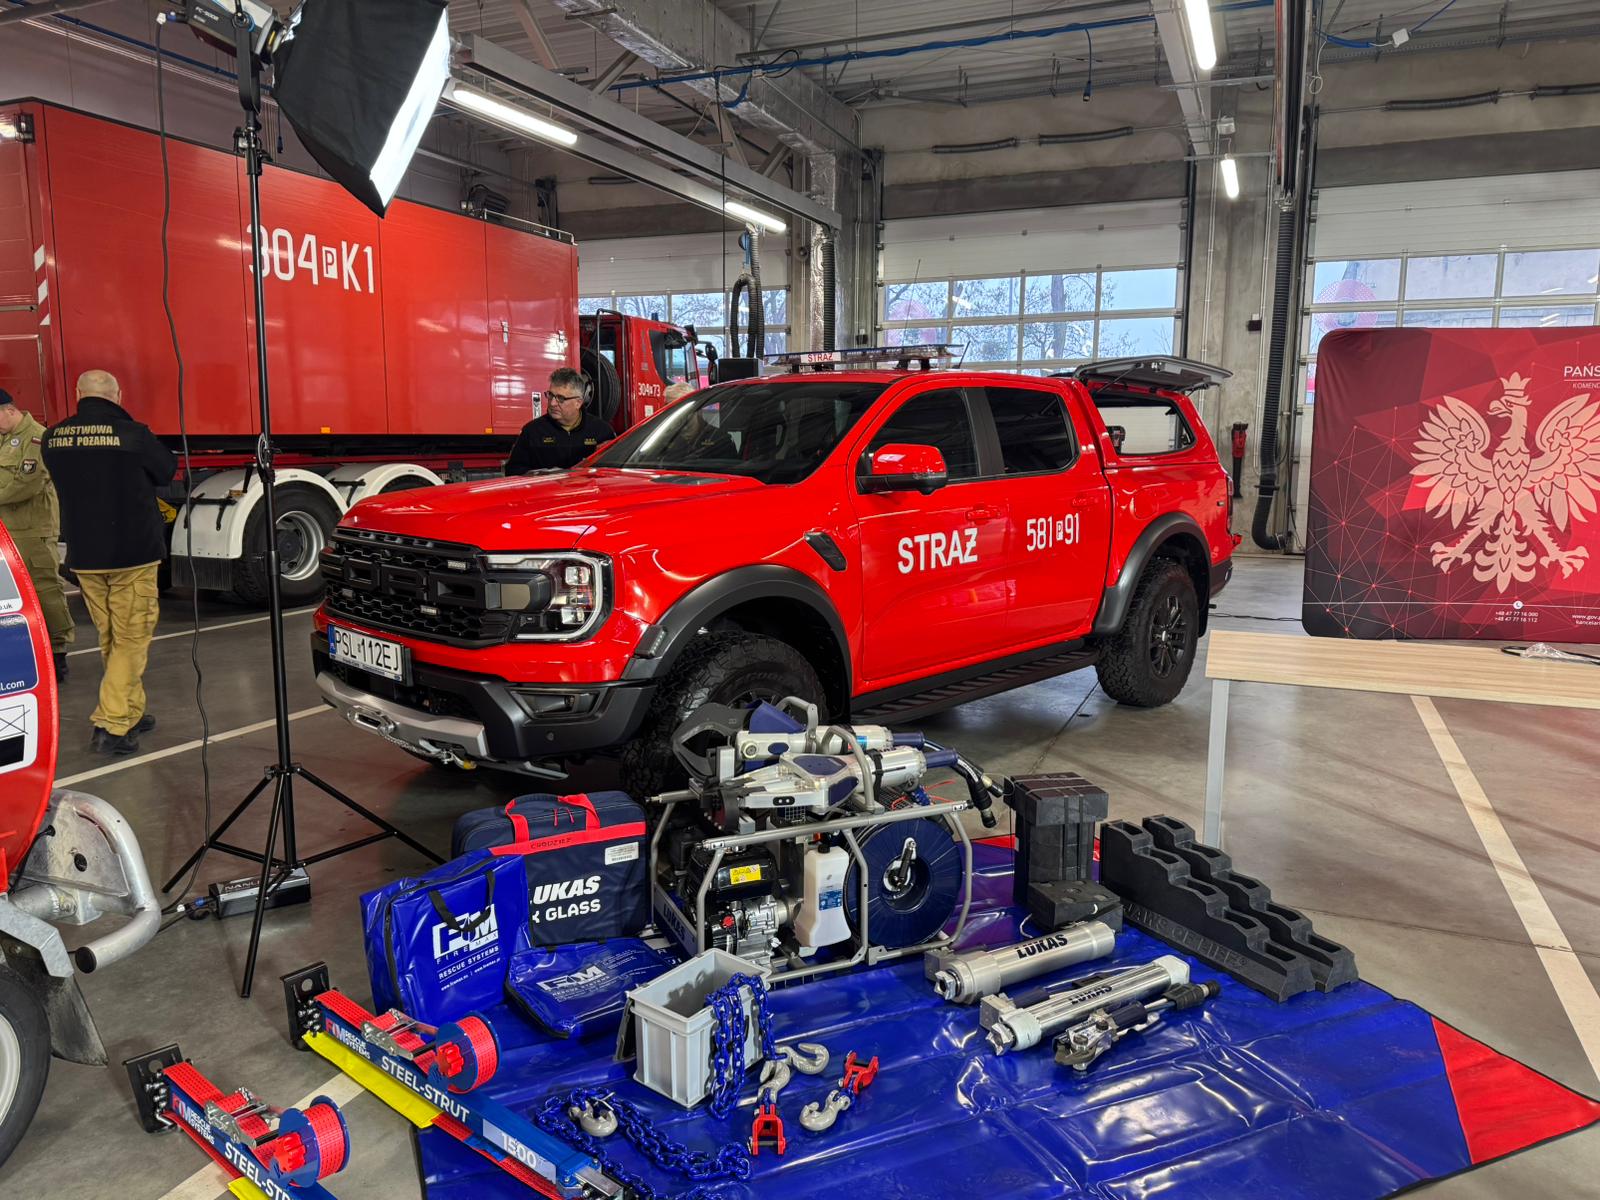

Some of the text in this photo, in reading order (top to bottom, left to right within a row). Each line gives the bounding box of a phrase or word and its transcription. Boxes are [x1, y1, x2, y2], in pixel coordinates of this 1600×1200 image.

[335, 629, 357, 660] PSL
[360, 637, 399, 672] 112EJ
[225, 880, 260, 892] NANLI
[530, 875, 601, 905] UKAS
[545, 898, 601, 921] GLASS
[436, 945, 469, 965] FIRE
[1014, 934, 1068, 959] LUKAS
[438, 945, 499, 980] RESCUE SYSTEMS
[345, 1030, 367, 1049] RESCUE
[381, 1055, 471, 1123] STEEL-STRUT
[190, 1109, 211, 1134] RESCUE
[500, 1131, 537, 1169] 1500
